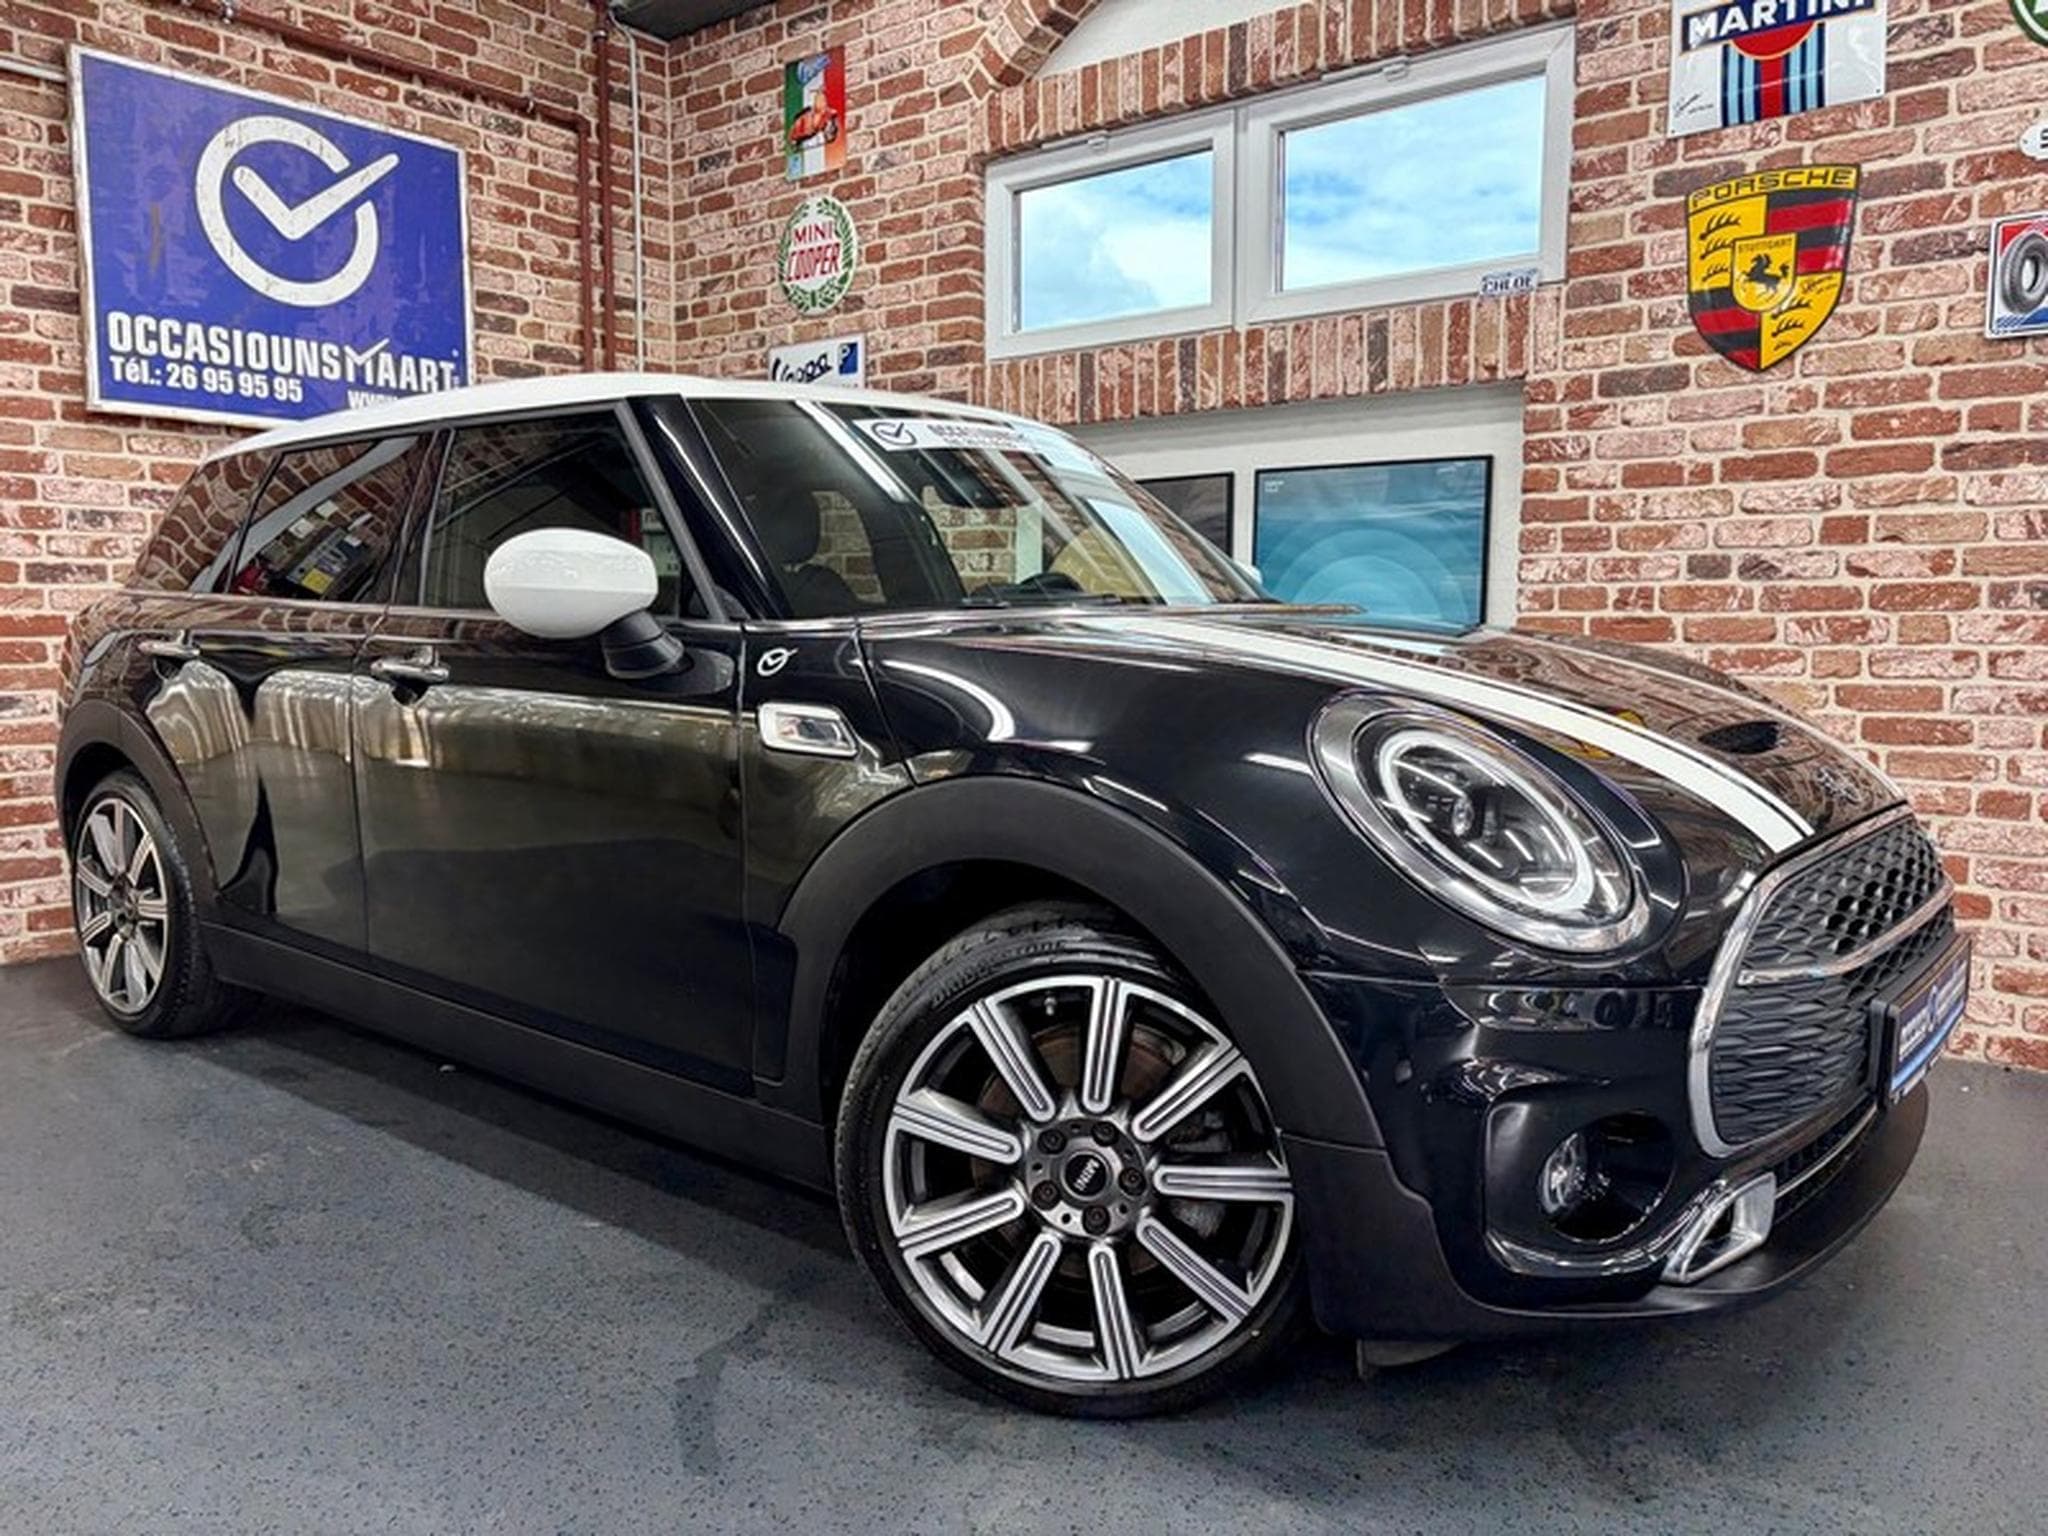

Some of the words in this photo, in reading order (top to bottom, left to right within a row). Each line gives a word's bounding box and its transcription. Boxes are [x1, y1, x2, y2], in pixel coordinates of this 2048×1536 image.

[1688, 0, 1866, 49] MARTI
[1692, 168, 1853, 208] PORSCHE
[794, 220, 833, 246] MINI
[787, 242, 841, 282] COOPER
[107, 310, 456, 393] OCCASIOUNSMAART
[110, 355, 162, 386] Tél.:
[166, 362, 198, 390] 26
[202, 367, 234, 395] 95
[238, 371, 269, 399] 95
[273, 376, 303, 403] 95
